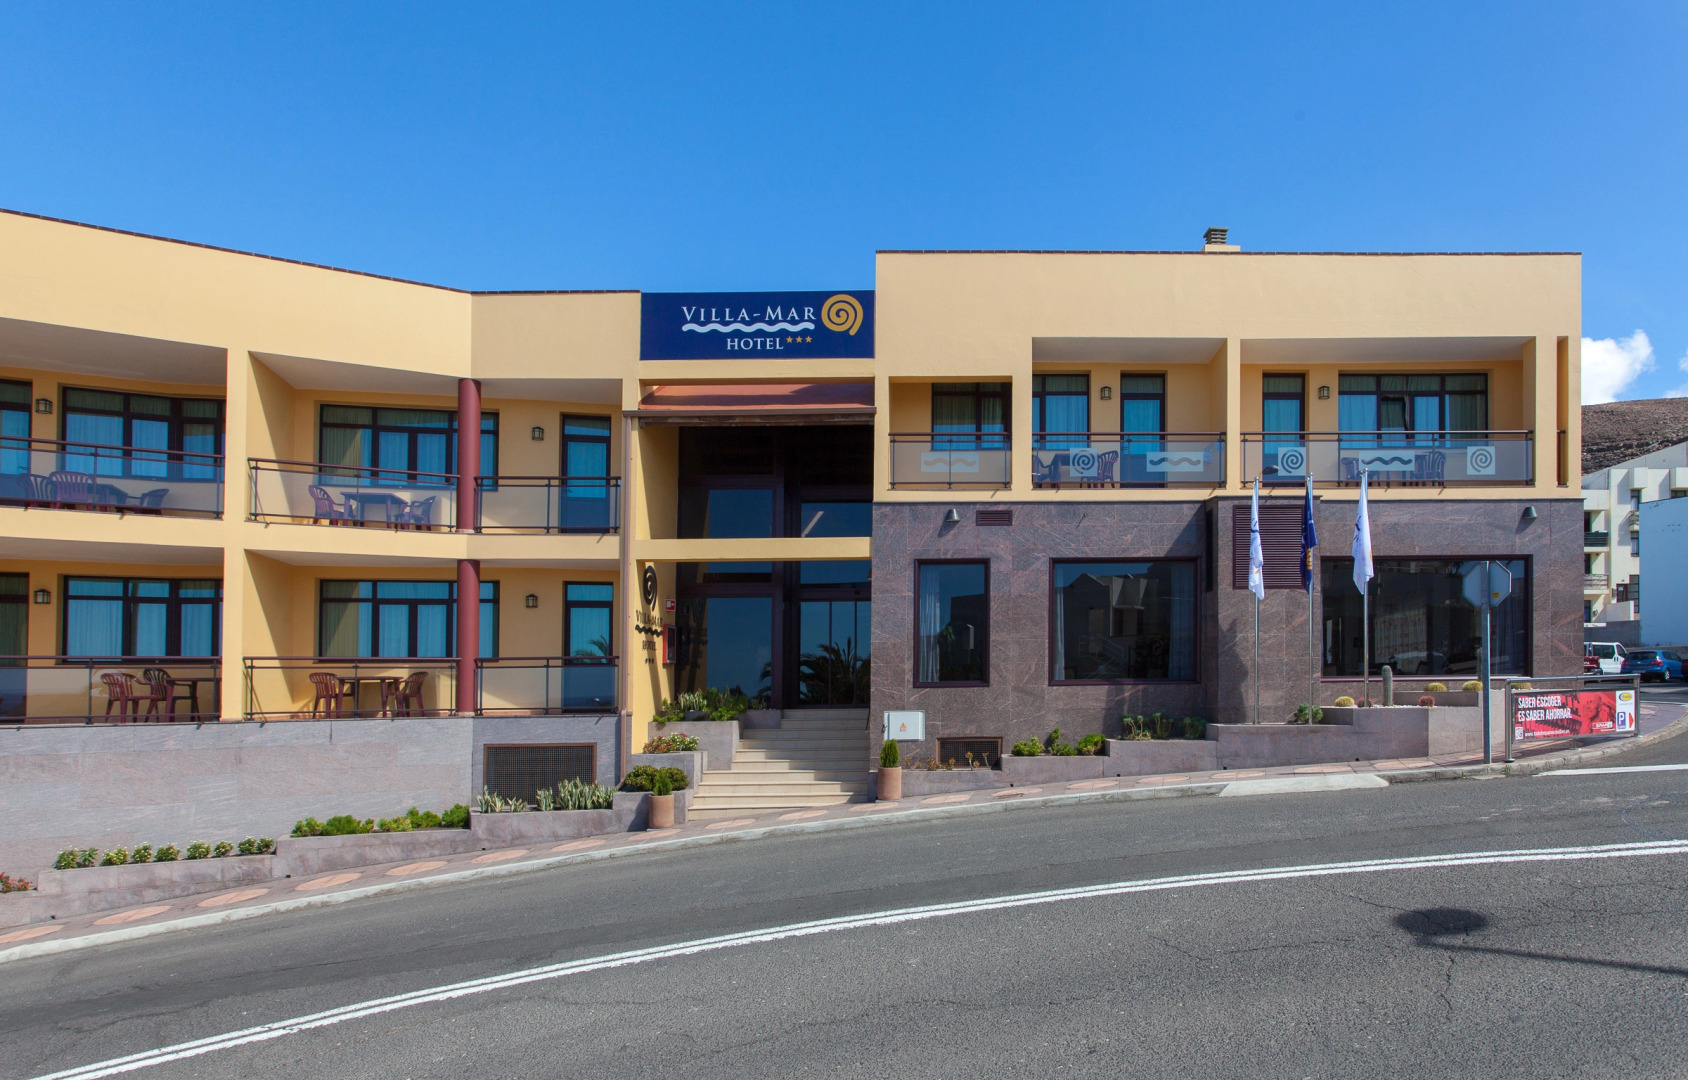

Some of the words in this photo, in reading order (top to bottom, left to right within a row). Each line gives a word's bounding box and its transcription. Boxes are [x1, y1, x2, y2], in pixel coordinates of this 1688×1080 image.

[681, 305, 816, 321] VILLA-MAR
[726, 337, 784, 350] HOTEL
[1518, 697, 1536, 708] SABER
[1537, 696, 1561, 708] ESCOGER
[1518, 711, 1525, 722] ES
[1526, 709, 1545, 721] SABER
[1619, 714, 1624, 726] P
